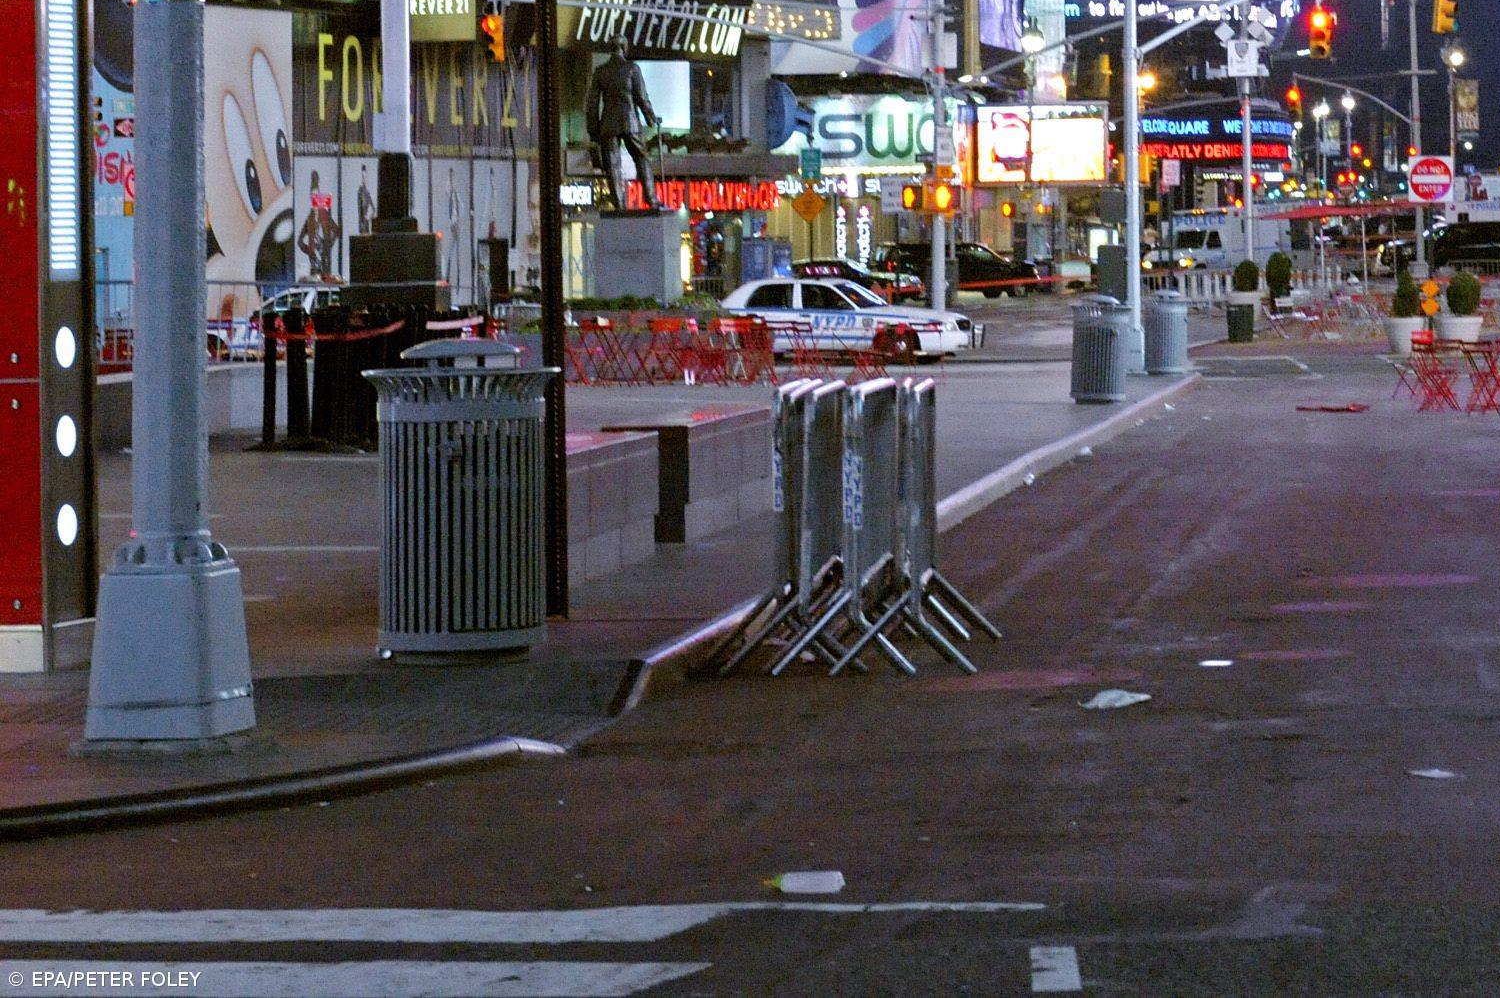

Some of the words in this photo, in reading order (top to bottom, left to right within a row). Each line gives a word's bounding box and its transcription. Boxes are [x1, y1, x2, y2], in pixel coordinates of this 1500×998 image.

[318, 33, 489, 127] FORVER
[1416, 165, 1428, 174] DO
[1429, 164, 1445, 174] NOT
[626, 180, 685, 211] PLNET
[1418, 183, 1444, 194] ENTER
[809, 314, 857, 330] NYPD
